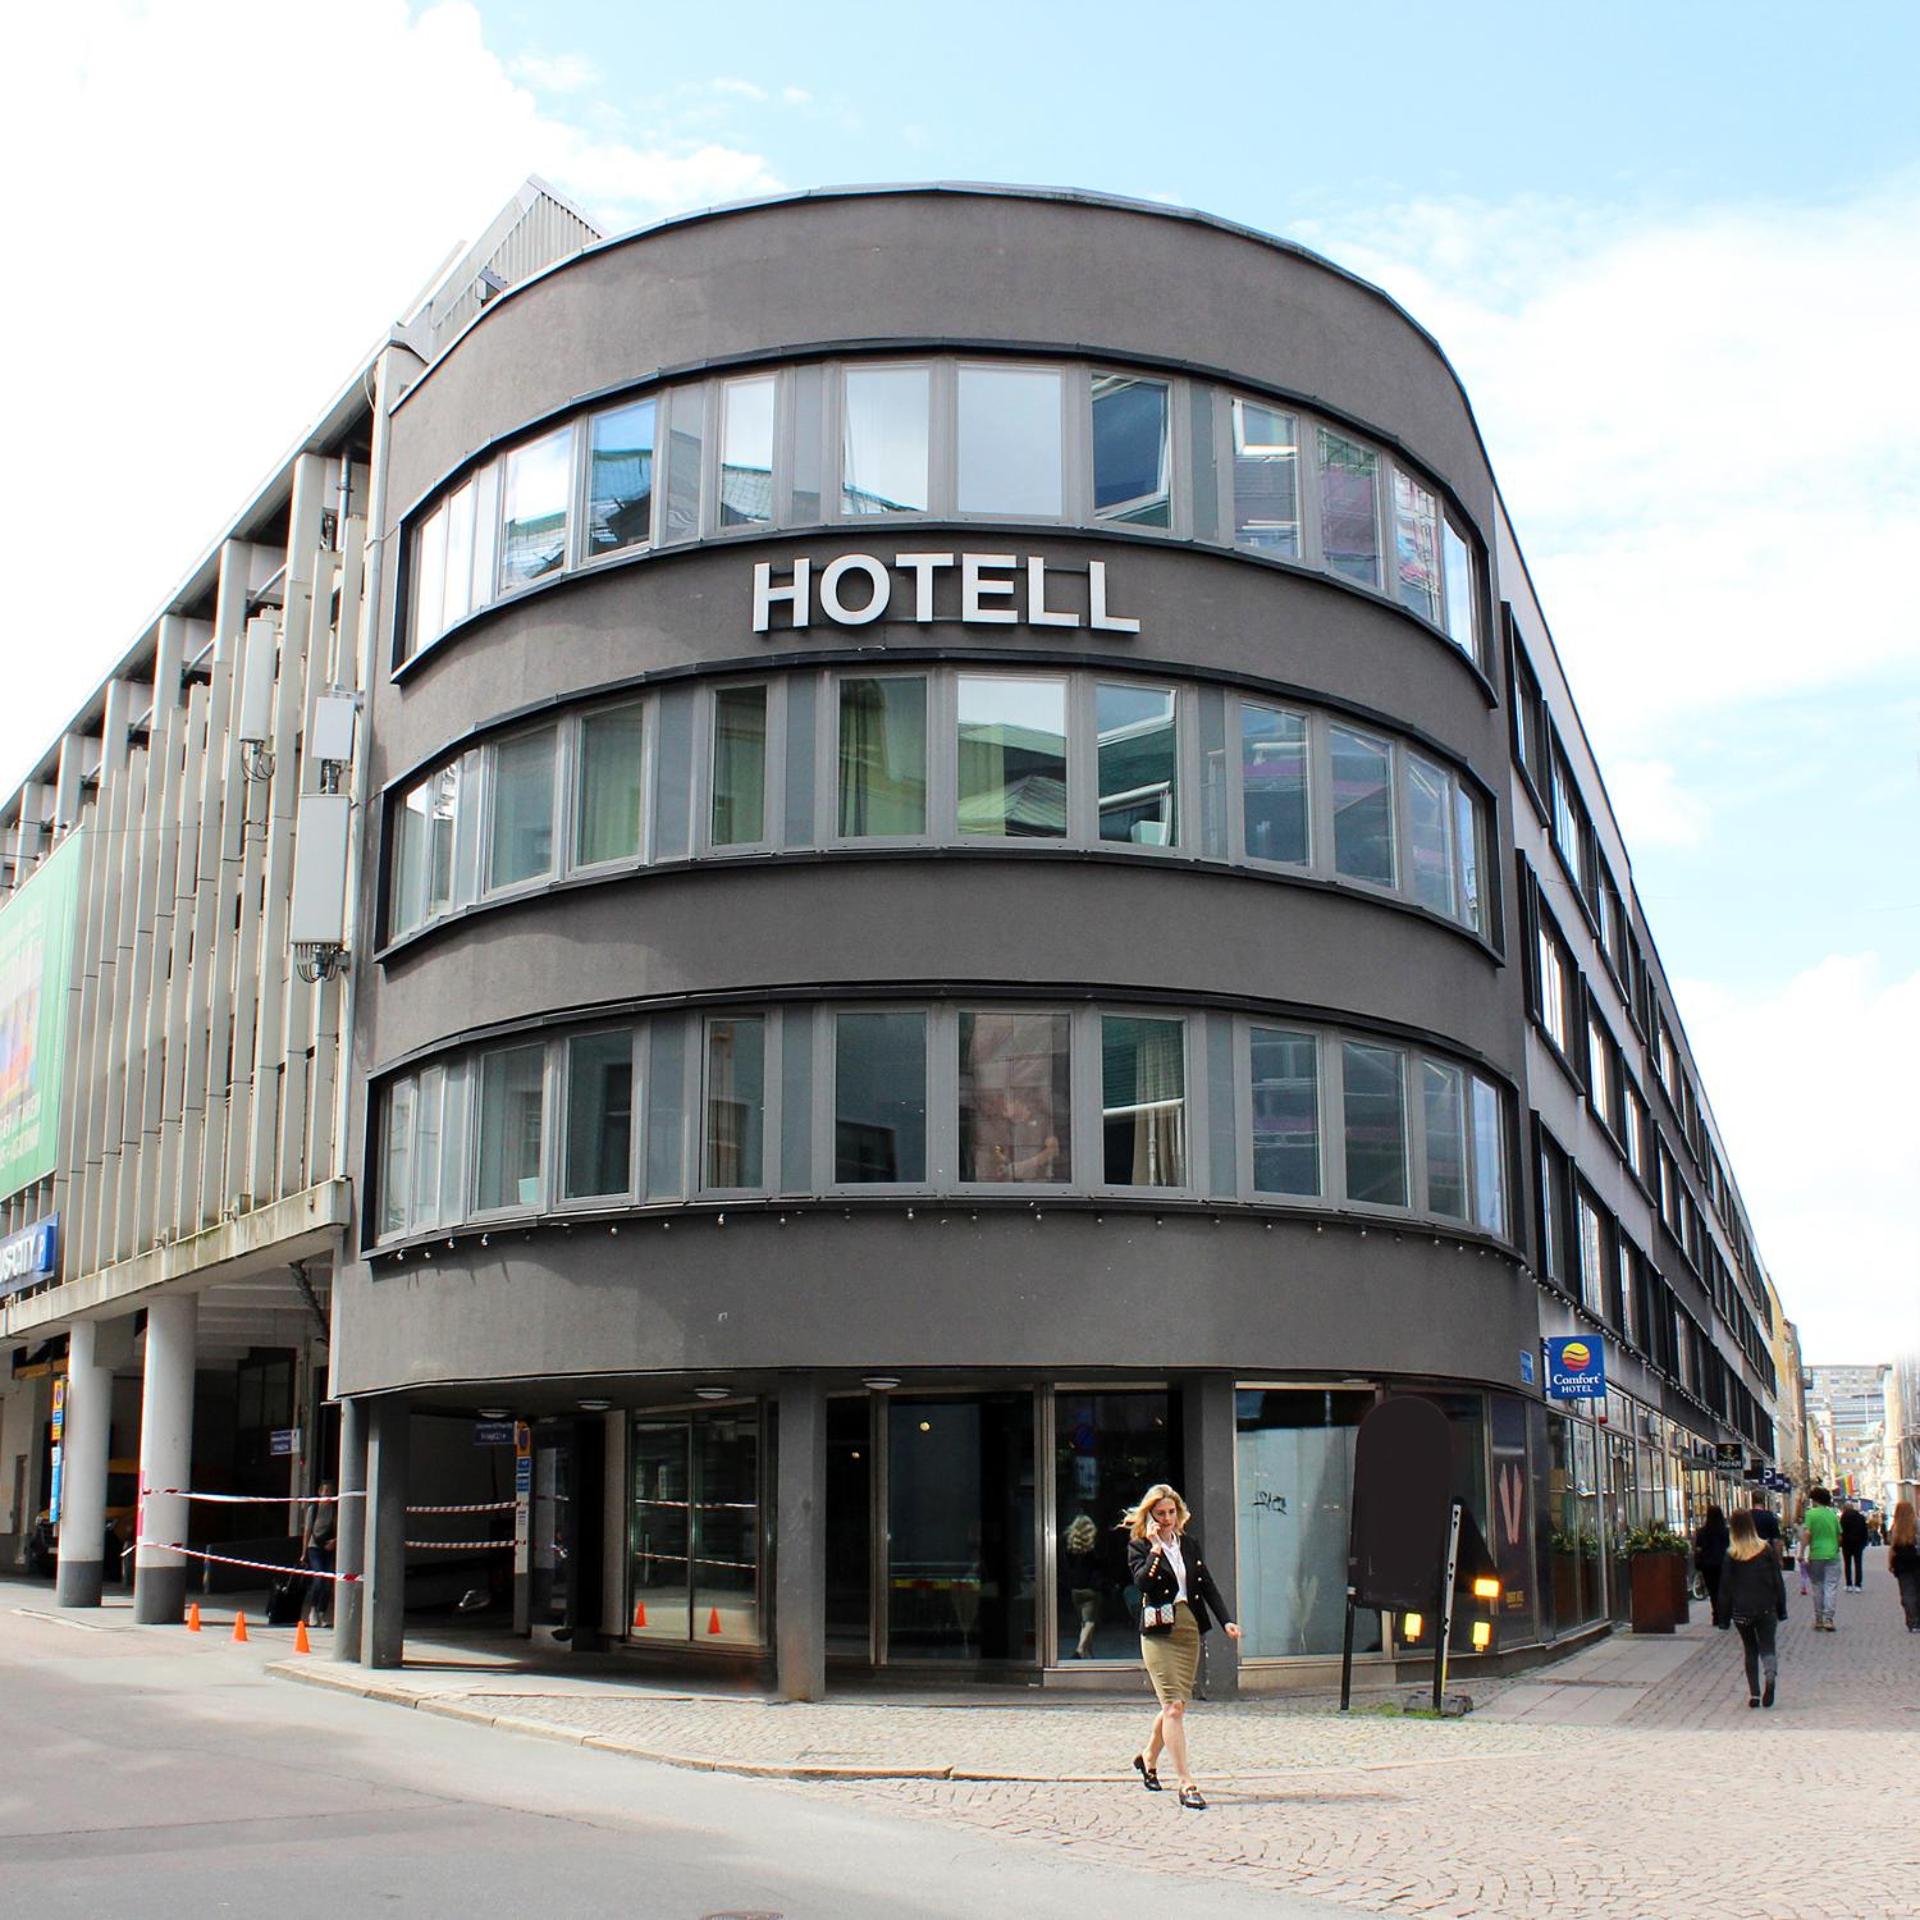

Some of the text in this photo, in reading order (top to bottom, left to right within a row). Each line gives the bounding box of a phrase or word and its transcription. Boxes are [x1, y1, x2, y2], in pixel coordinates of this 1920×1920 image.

[752, 553, 1141, 634] HOTELL
[1553, 1372, 1600, 1385] Comfort
[1561, 1384, 1594, 1393] HOTEL
